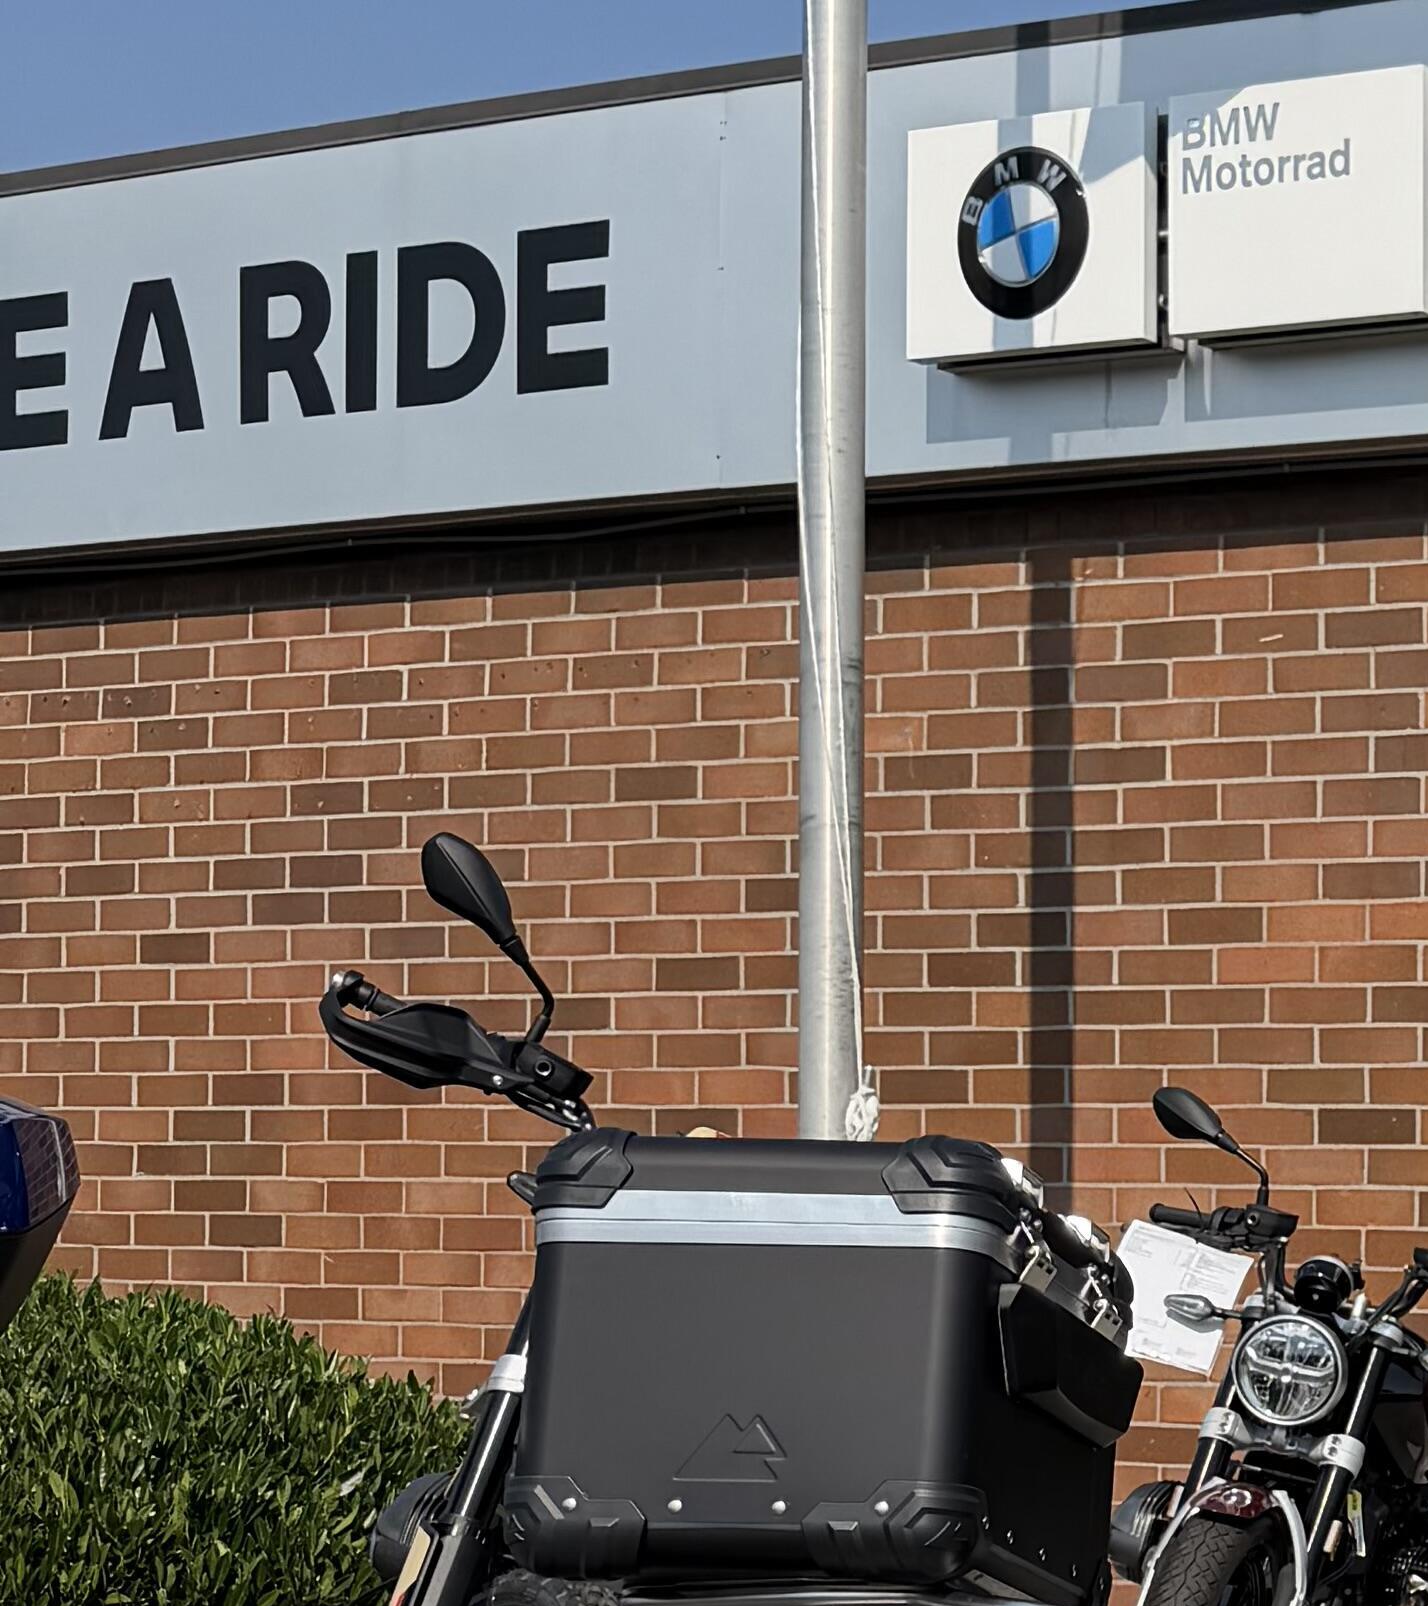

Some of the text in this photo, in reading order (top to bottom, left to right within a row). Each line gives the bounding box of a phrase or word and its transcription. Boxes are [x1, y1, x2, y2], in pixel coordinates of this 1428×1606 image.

[1182, 102, 1280, 150] BMW
[961, 161, 1065, 227] BMW
[1181, 138, 1351, 195] Motorrad
[99, 278, 204, 441] A
[240, 219, 610, 425] RIDE
